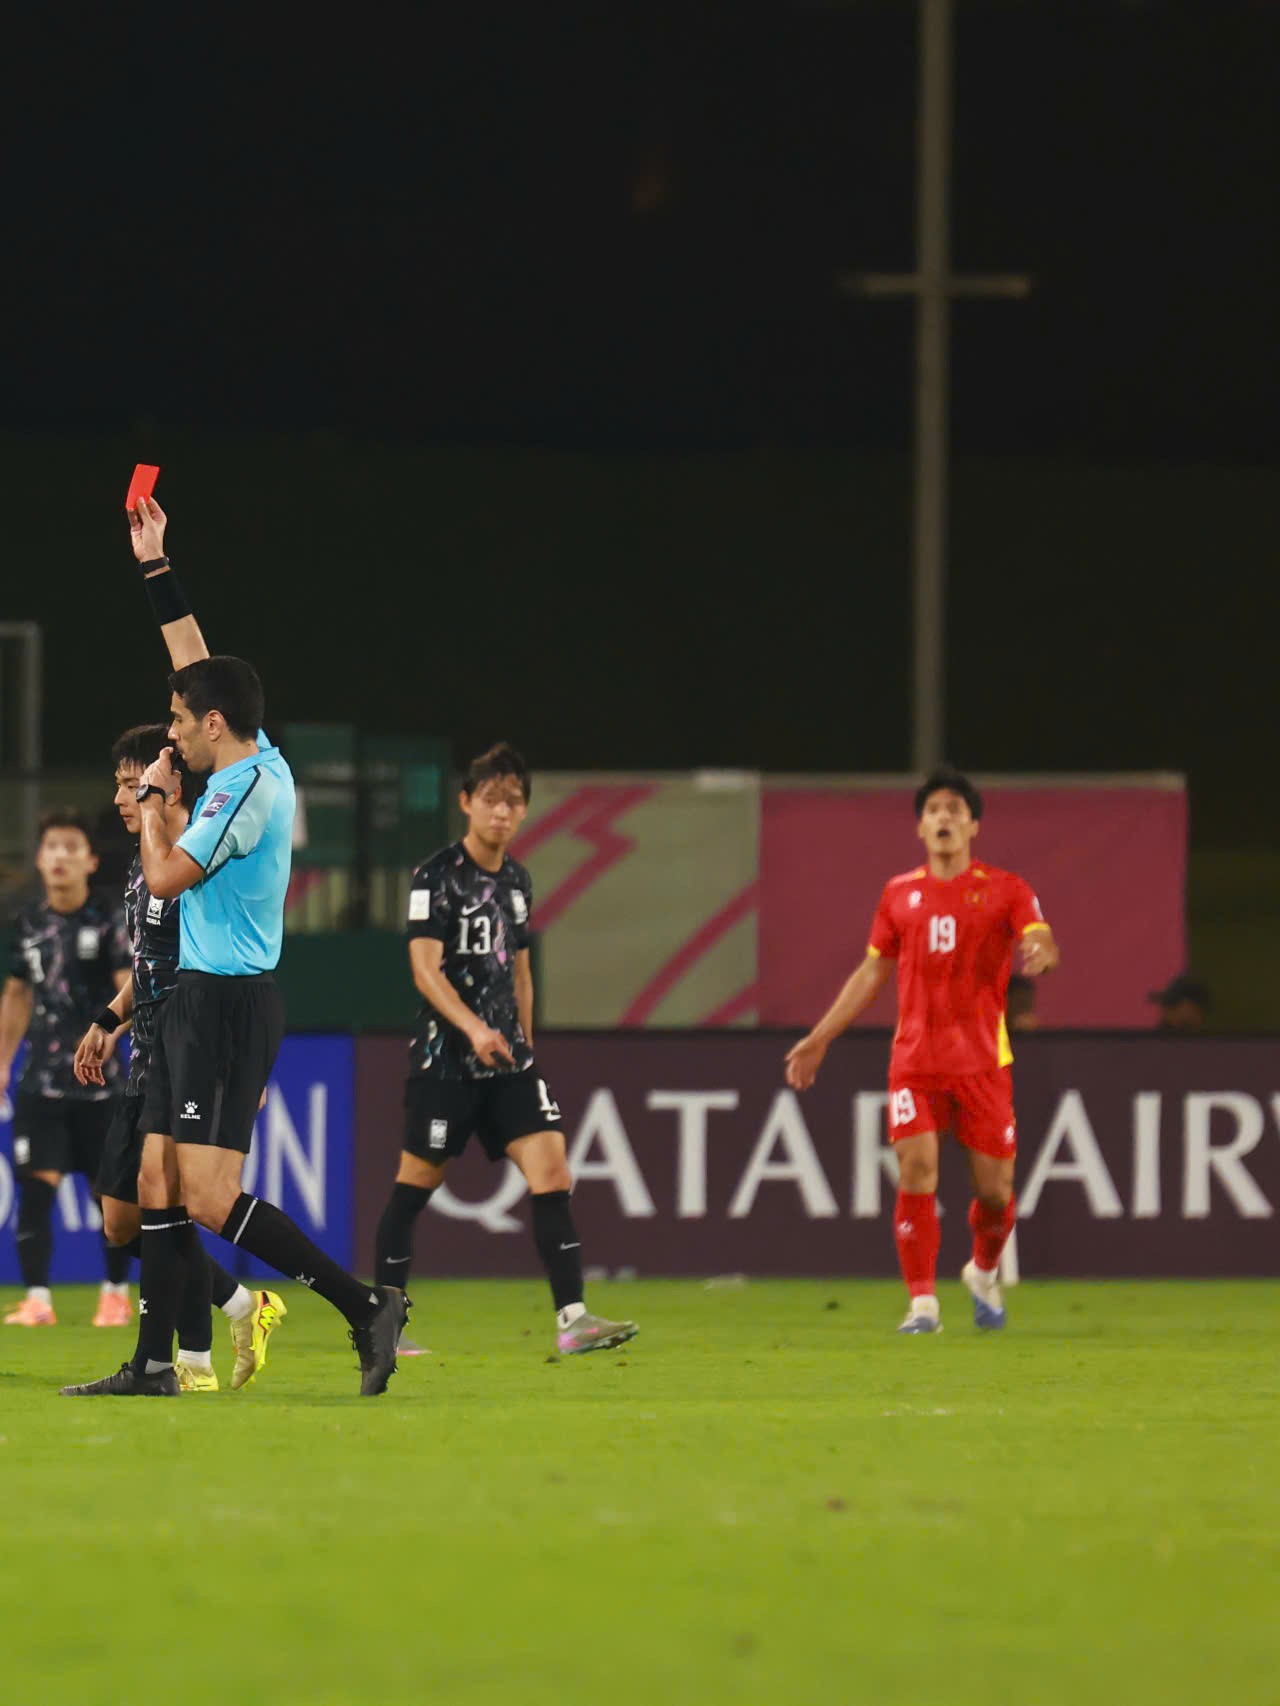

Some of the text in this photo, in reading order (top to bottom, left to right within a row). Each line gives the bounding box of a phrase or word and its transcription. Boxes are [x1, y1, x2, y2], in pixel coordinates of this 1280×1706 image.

[456, 915, 492, 955] 13
[928, 914, 957, 954] 19
[888, 1087, 918, 1128] 19
[1017, 1086, 1280, 1219] AIR
